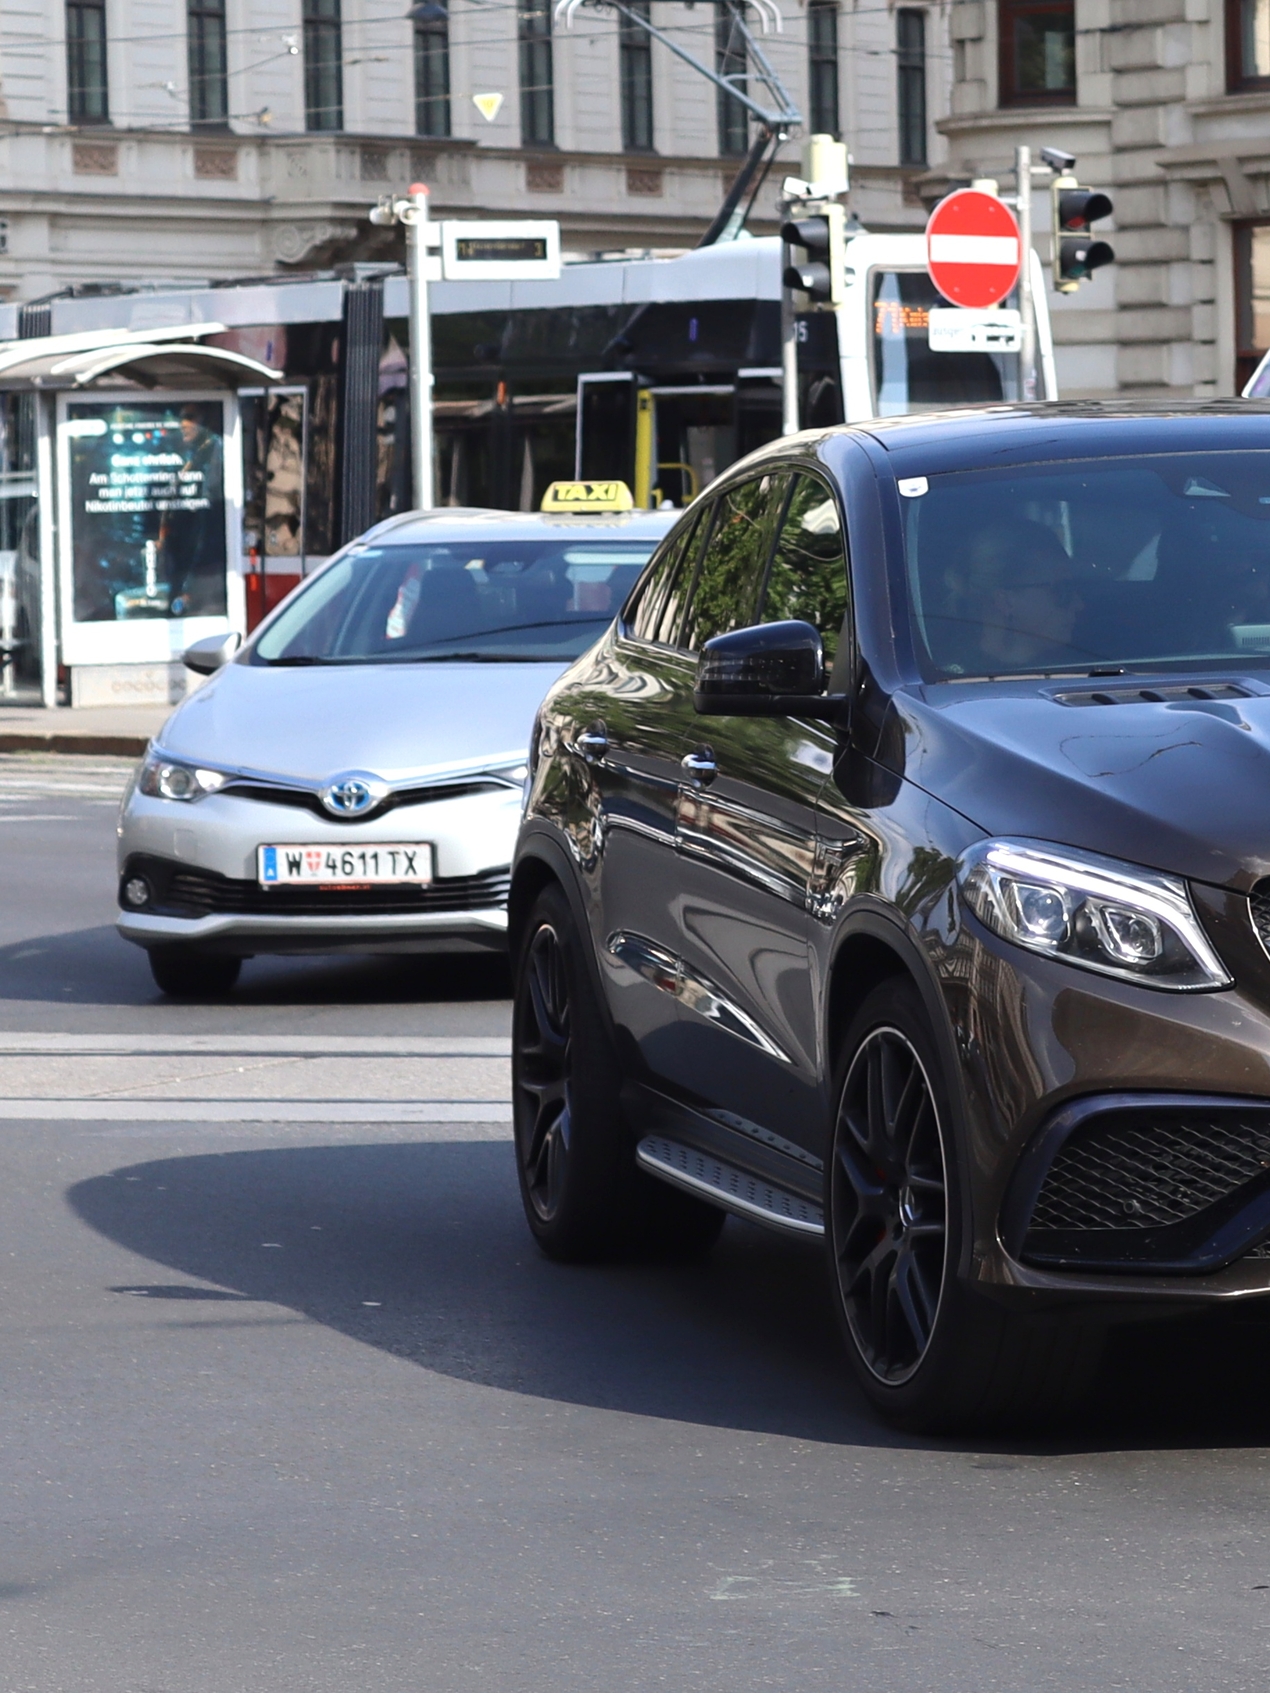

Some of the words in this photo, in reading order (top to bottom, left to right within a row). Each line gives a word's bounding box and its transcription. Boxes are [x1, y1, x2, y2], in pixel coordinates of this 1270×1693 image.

[874, 301, 900, 334] 71
[89, 473, 108, 485] Am
[110, 471, 175, 485] Schottenring
[98, 487, 122, 499] man
[554, 484, 618, 501] TAXI
[285, 851, 303, 877] W
[266, 868, 275, 877] A
